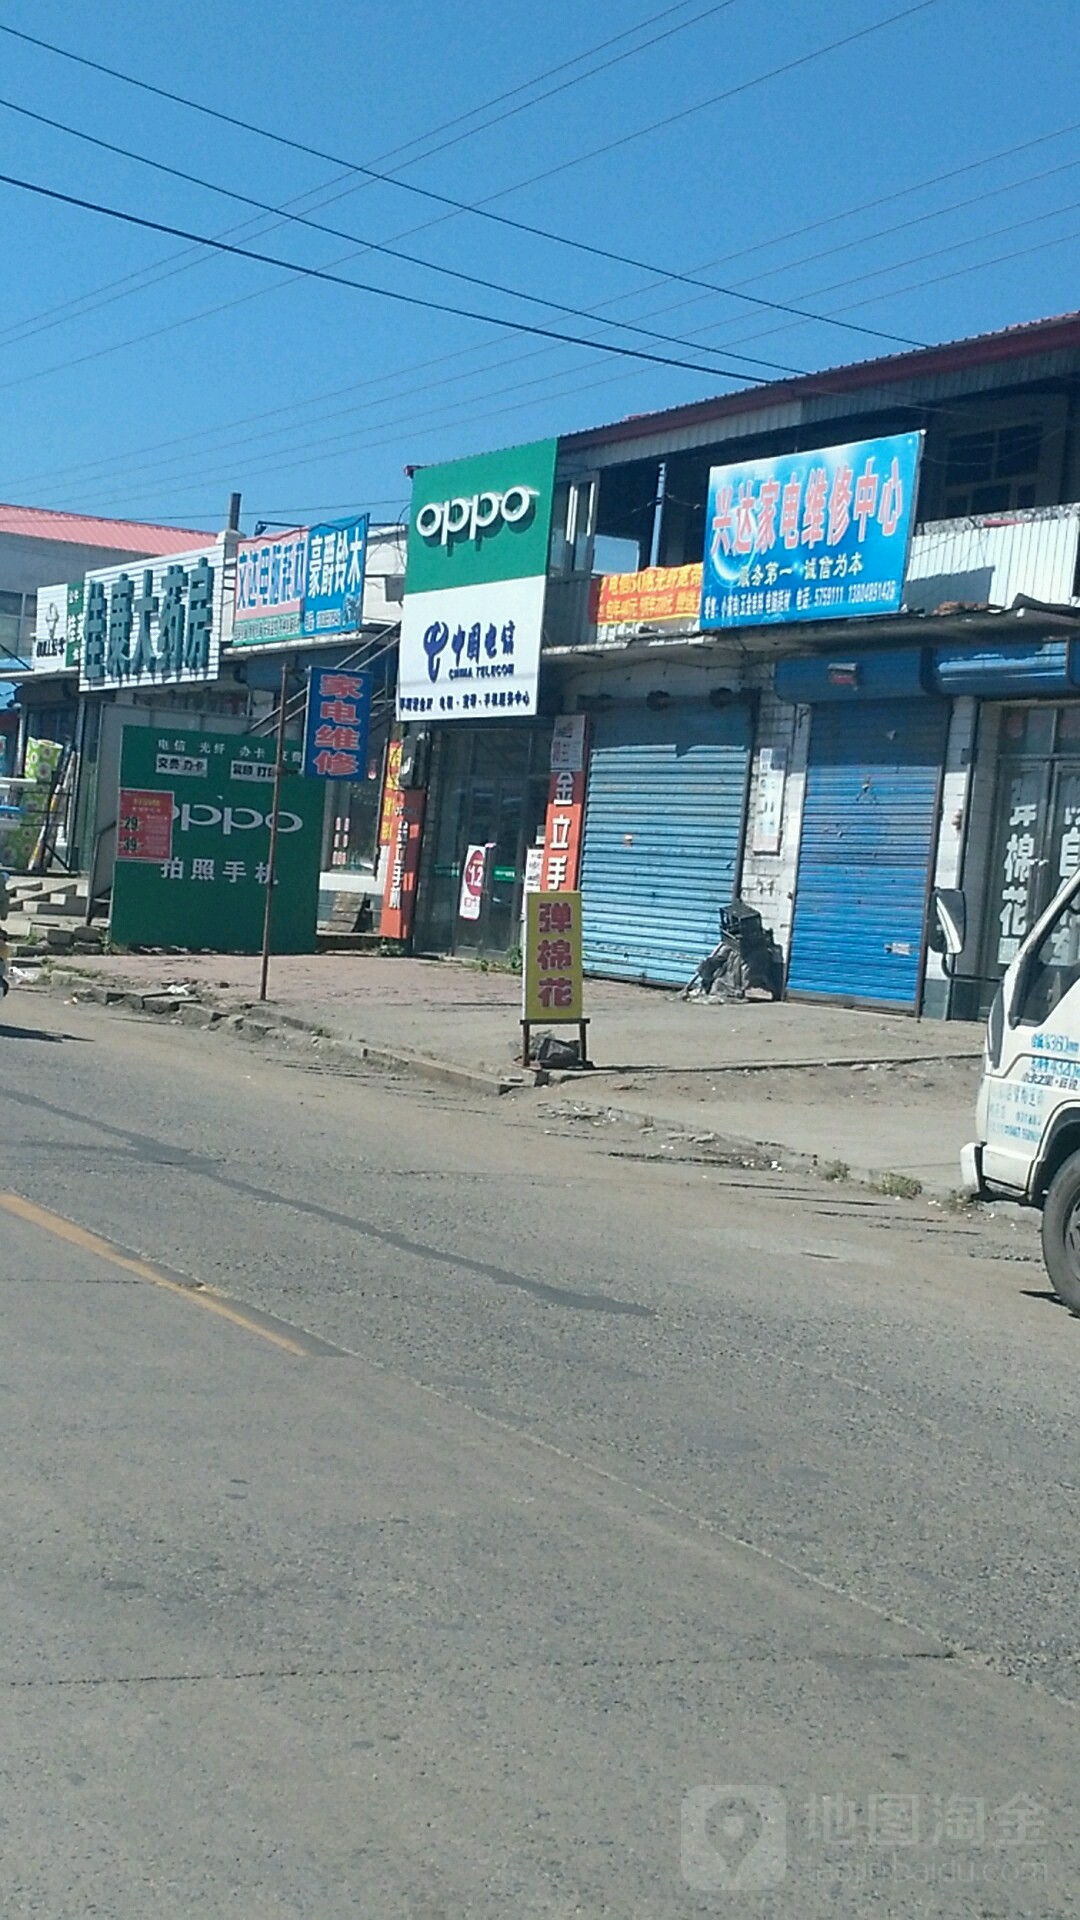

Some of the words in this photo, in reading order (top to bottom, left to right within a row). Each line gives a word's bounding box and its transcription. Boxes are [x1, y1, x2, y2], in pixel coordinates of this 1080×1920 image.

[416, 486, 532, 546] oppo
[711, 456, 903, 557] 兴达家电维修中心
[738, 561, 793, 588] 服务第一
[804, 552, 863, 580] 诚信为本
[451, 620, 516, 668] 中国电信
[449, 667, 473, 680] CHINA
[476, 664, 514, 678] TELECOM
[313, 674, 363, 776] 家电维修
[158, 739, 186, 752] 电信
[200, 742, 225, 755] 光纤
[240, 746, 265, 758] 办卡
[173, 803, 303, 835] ppo
[160, 857, 279, 885] 拍照手机
[536, 902, 573, 1009] 弹棉花
